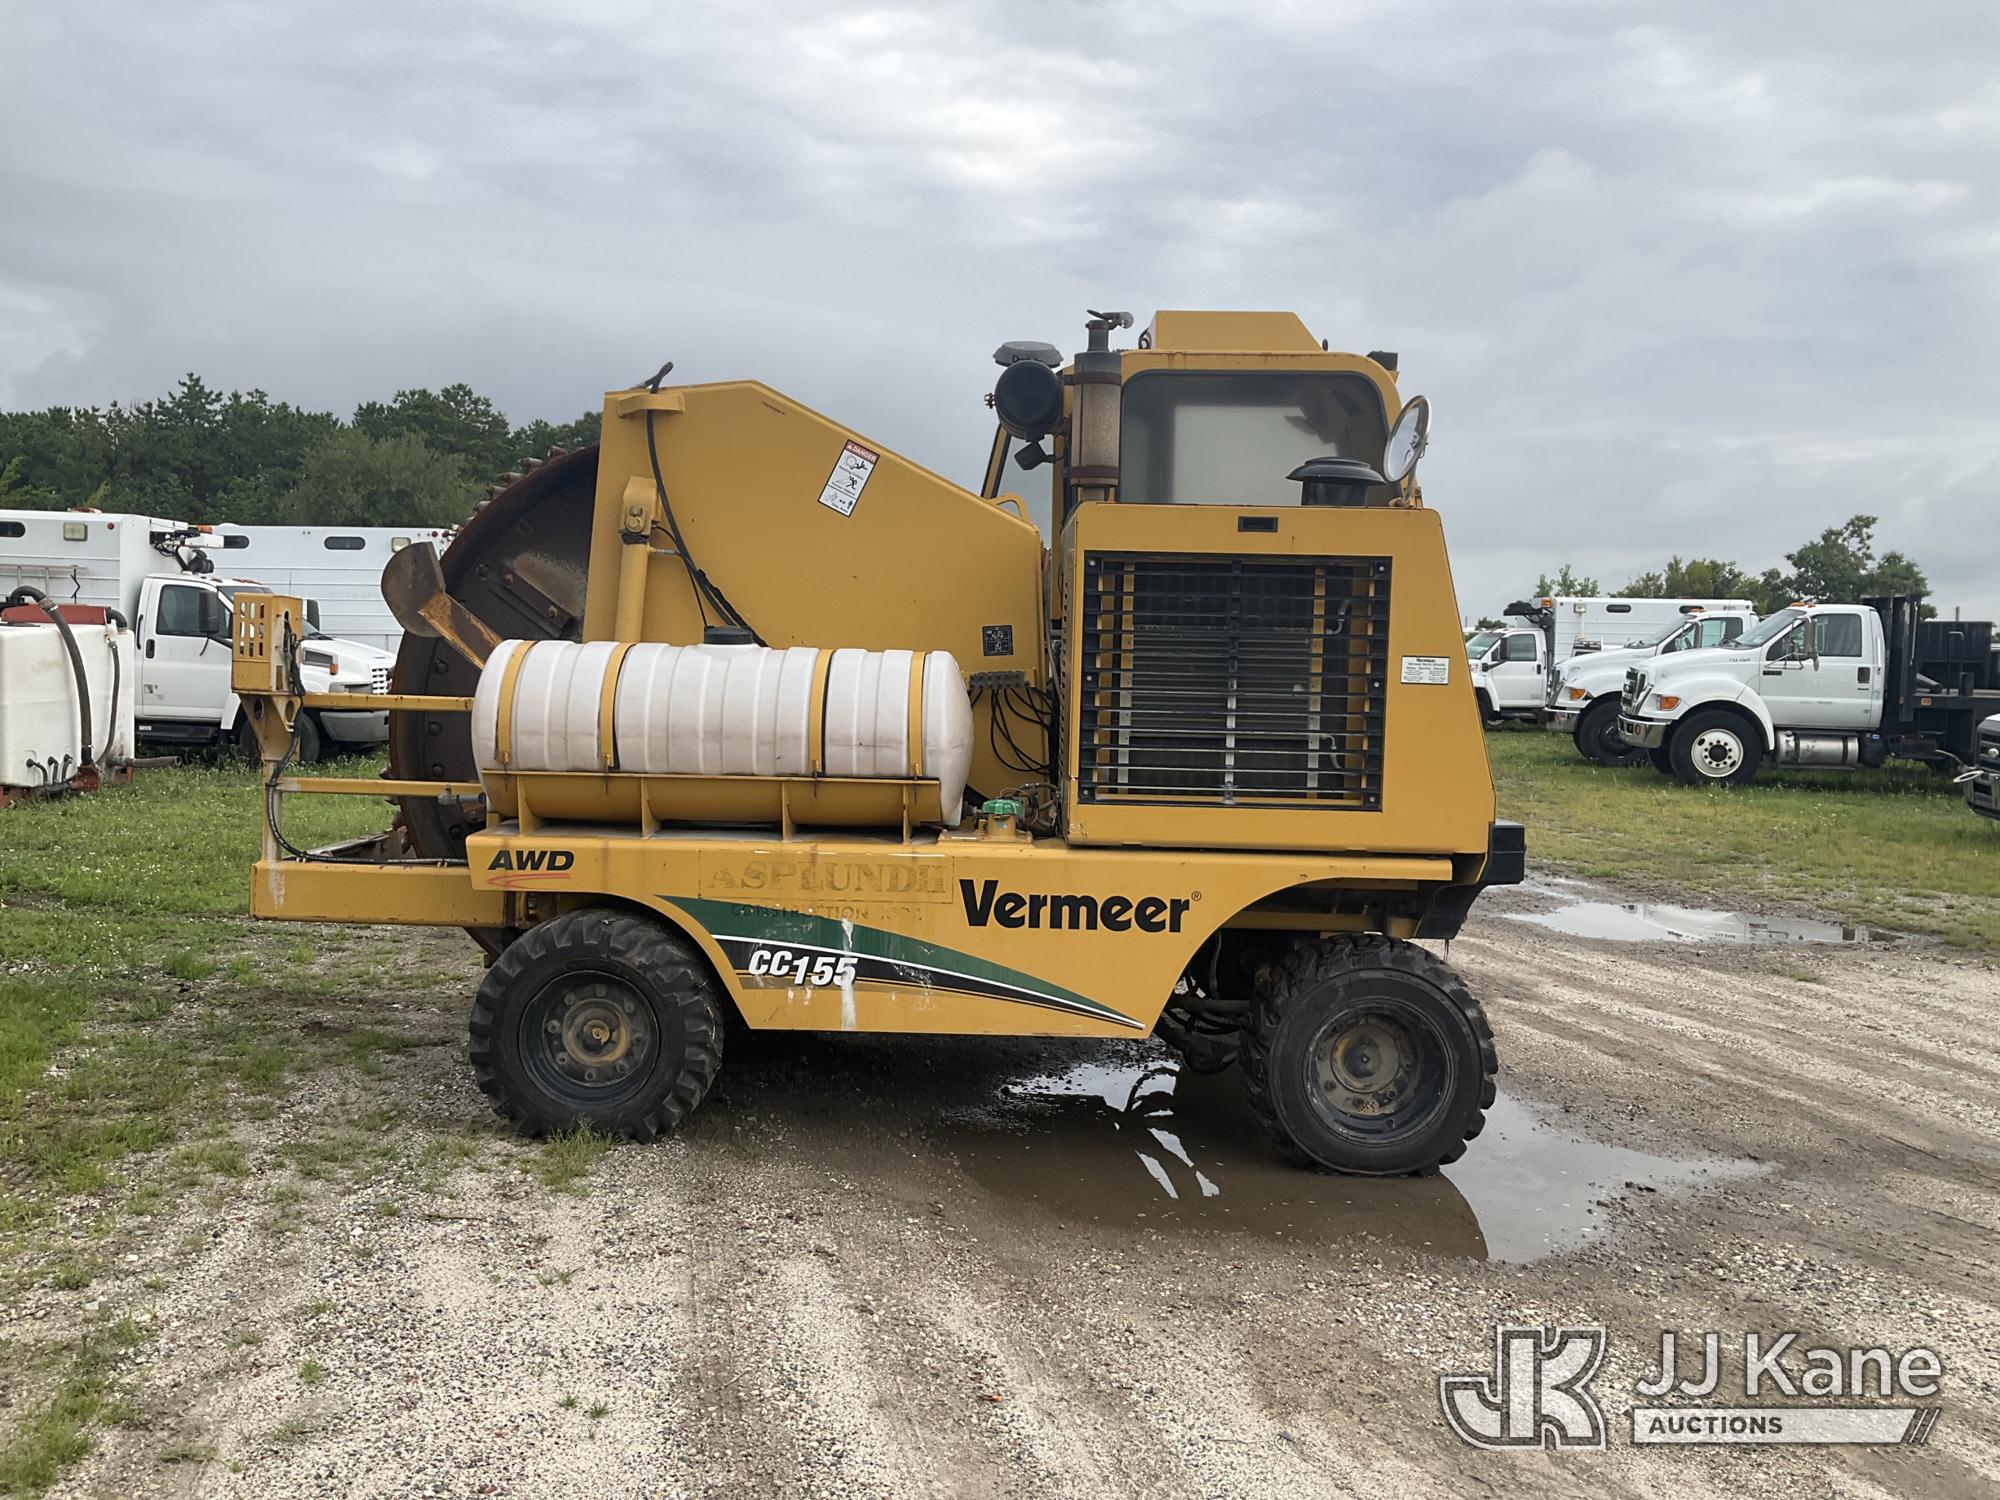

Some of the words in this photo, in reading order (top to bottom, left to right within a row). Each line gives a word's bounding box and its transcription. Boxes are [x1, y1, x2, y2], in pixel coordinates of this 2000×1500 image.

[487, 850, 574, 871] AWD
[708, 860, 947, 894] ASPLUNDH
[749, 950, 859, 987] CC155
